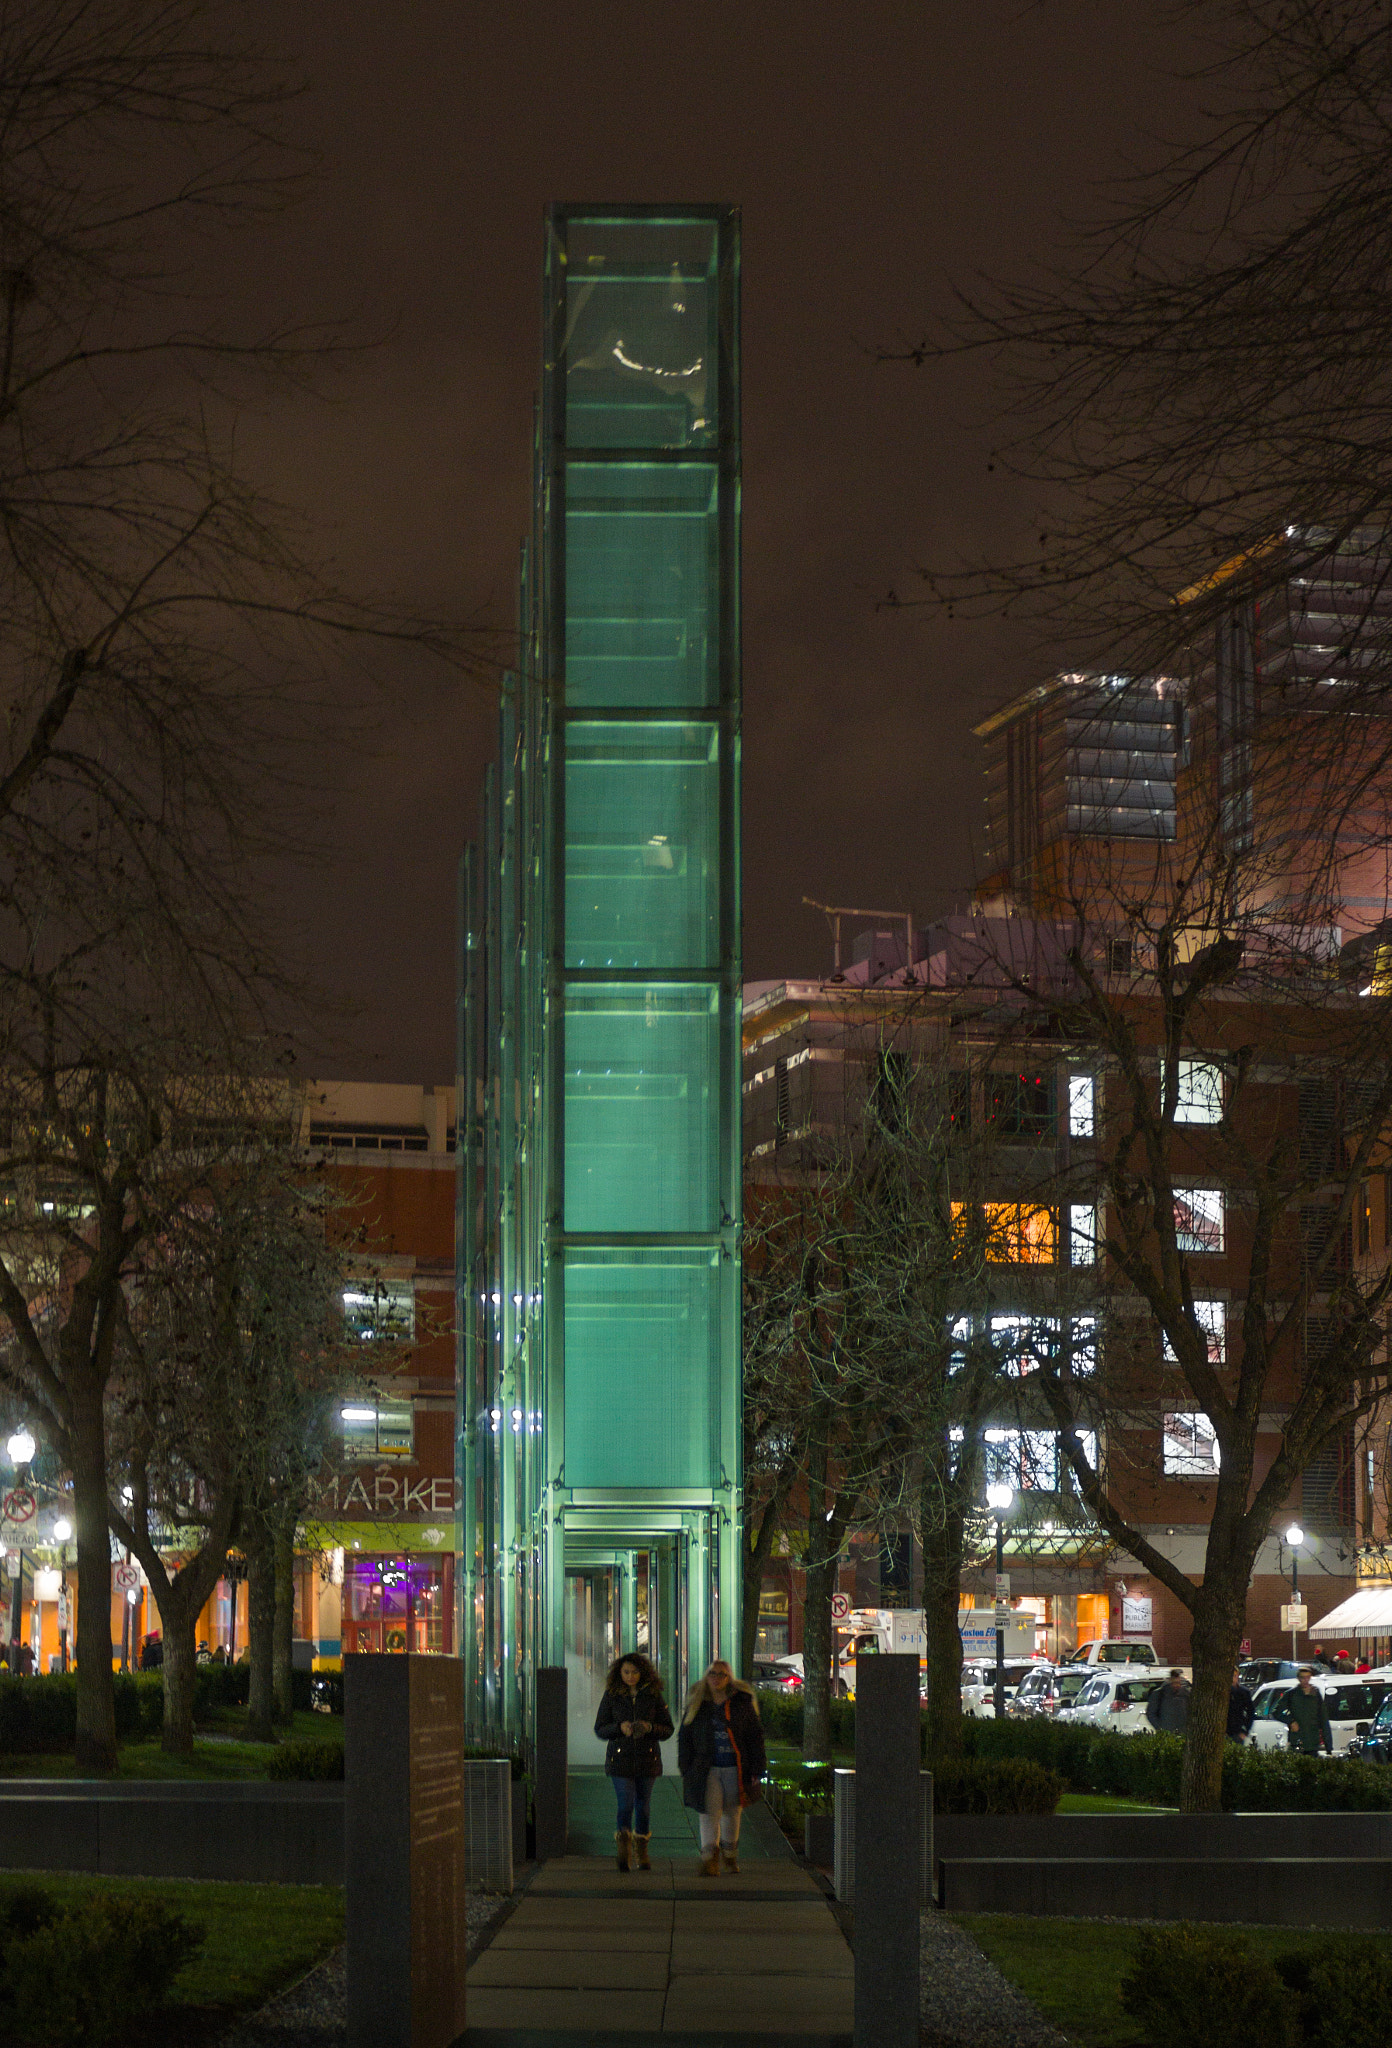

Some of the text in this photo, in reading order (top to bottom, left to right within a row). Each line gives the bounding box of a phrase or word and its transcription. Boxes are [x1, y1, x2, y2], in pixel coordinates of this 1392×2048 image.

[307, 1475, 454, 1511] MARKE
[4, 1534, 35, 1545] AHEAD
[900, 1634, 922, 1643] 9-1-1
